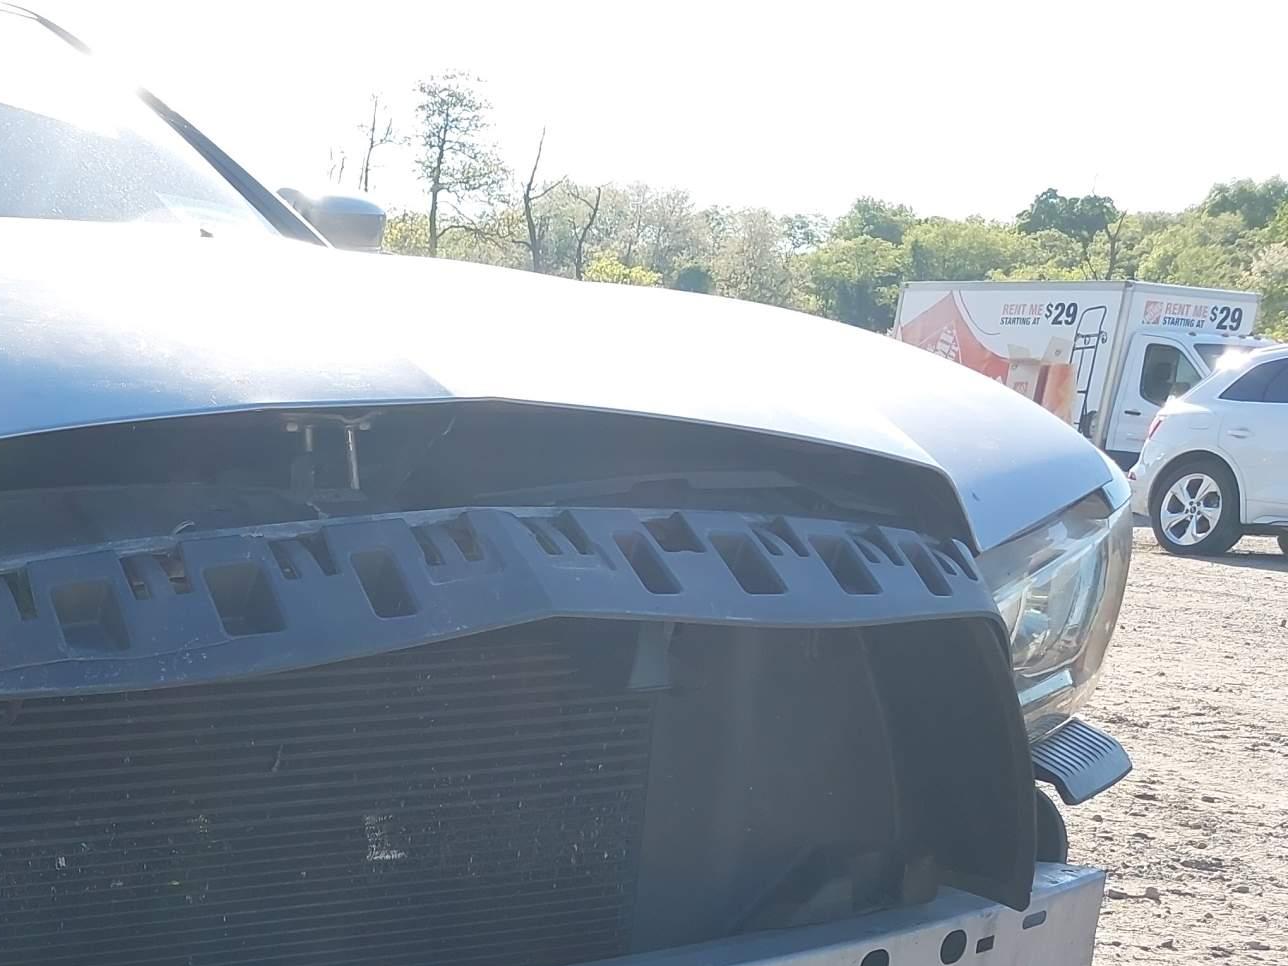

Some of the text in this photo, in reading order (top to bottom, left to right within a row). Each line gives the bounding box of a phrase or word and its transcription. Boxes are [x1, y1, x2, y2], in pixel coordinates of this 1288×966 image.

[1002, 303, 1044, 316] RENT ME
[1045, 302, 1078, 325] $29
[1165, 303, 1192, 315] RENT
[1192, 304, 1209, 318] ME
[1000, 317, 1040, 326] STARTING AT
[1162, 317, 1205, 329] STARTING AT
[1209, 305, 1243, 331] $29
